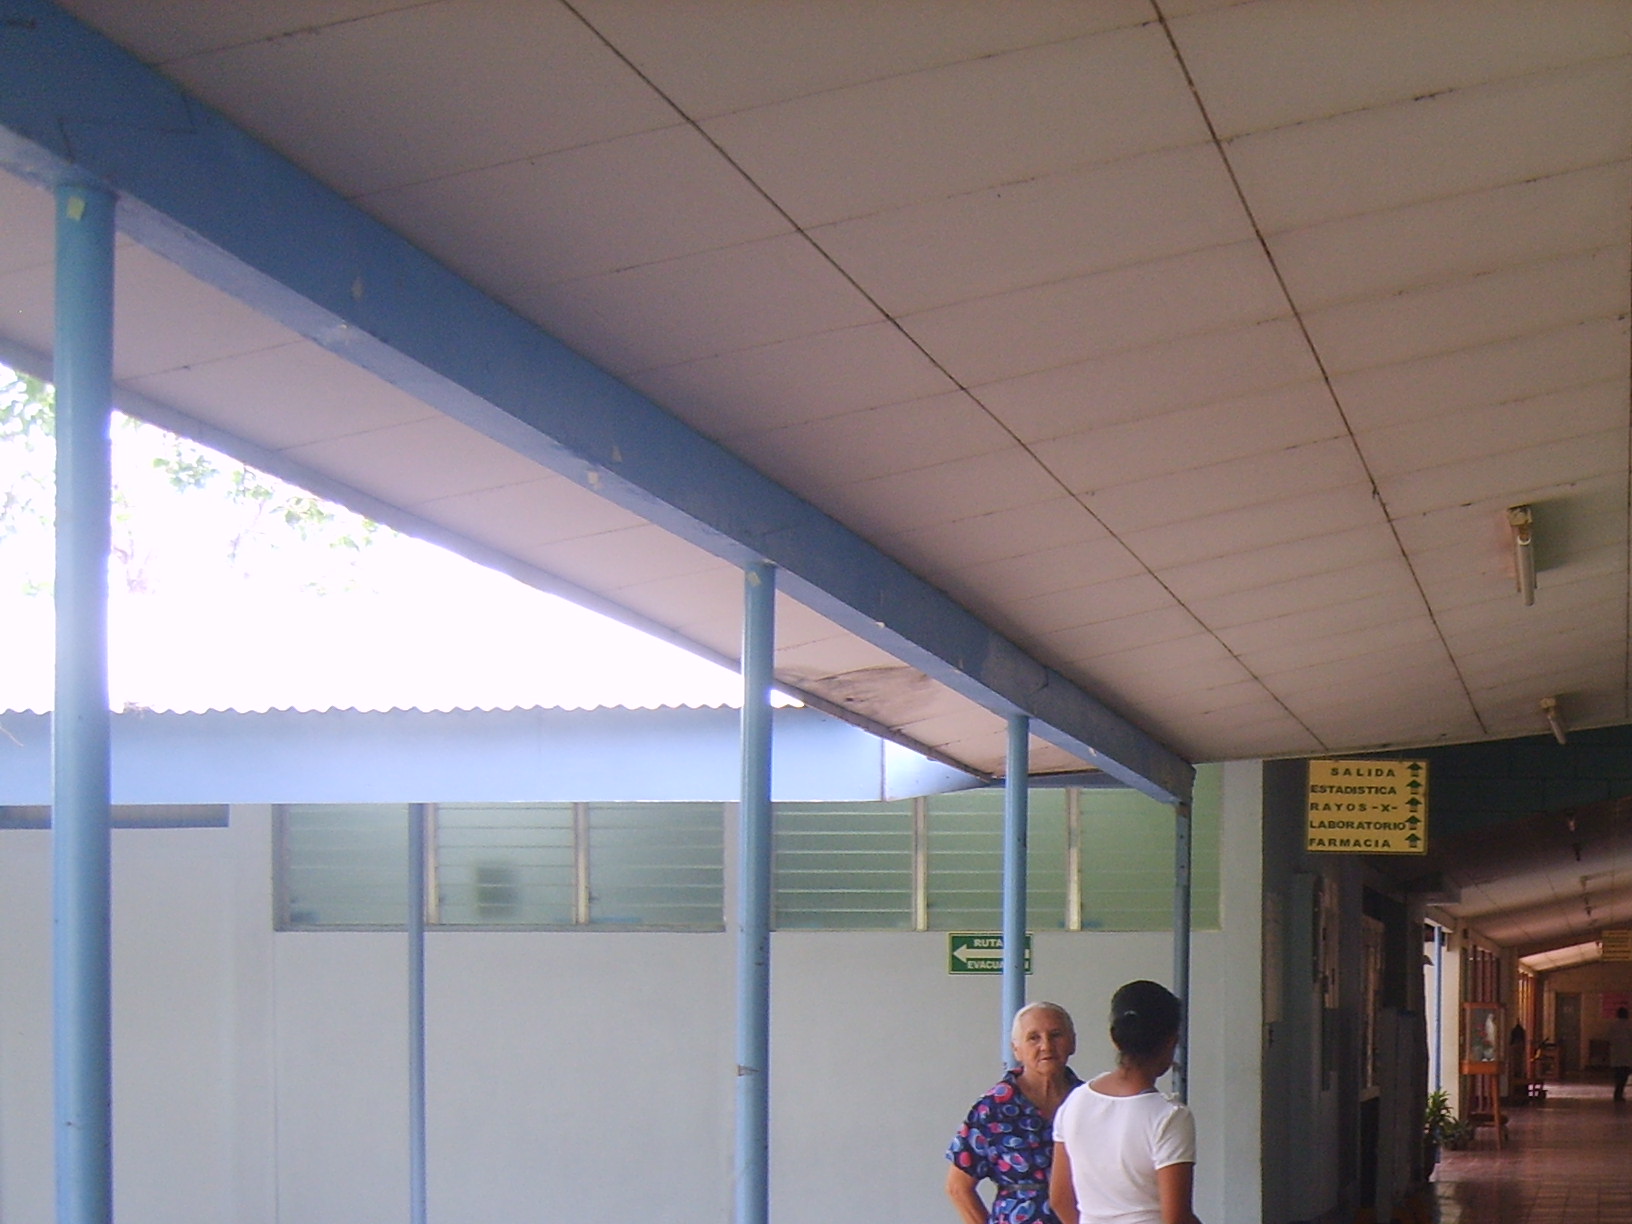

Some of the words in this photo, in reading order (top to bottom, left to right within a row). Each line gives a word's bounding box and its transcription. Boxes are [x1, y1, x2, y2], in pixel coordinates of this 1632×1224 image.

[1330, 767, 1396, 778] SALIDA
[1310, 784, 1398, 796] ESTADISTICA
[1310, 802, 1368, 812] RAYOS
[1309, 820, 1407, 831] LABORATORIO
[1308, 838, 1392, 849] FARMACIA
[973, 938, 1004, 947] RUTA
